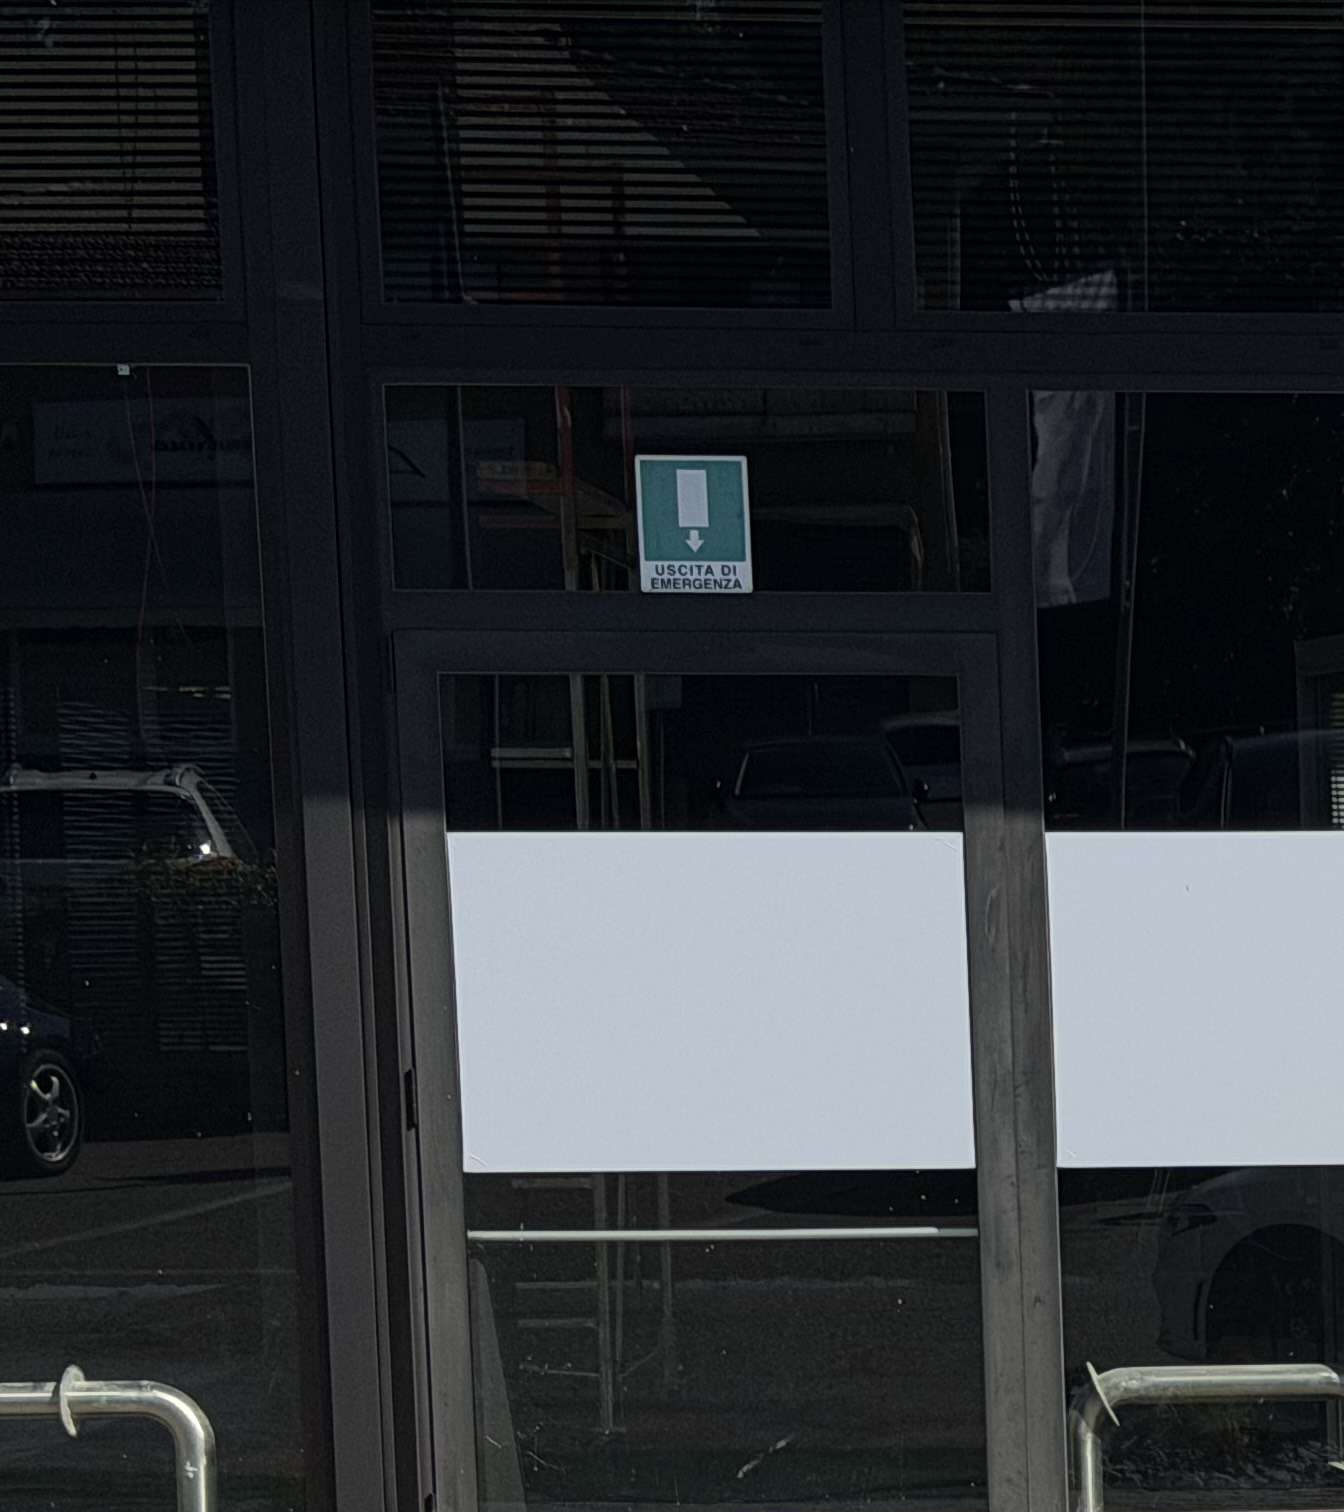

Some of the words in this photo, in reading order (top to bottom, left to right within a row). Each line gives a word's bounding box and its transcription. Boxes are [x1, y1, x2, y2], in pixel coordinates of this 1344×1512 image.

[655, 564, 715, 577] USCITA
[721, 564, 737, 577] DI
[650, 577, 742, 590] EMERGENZA
